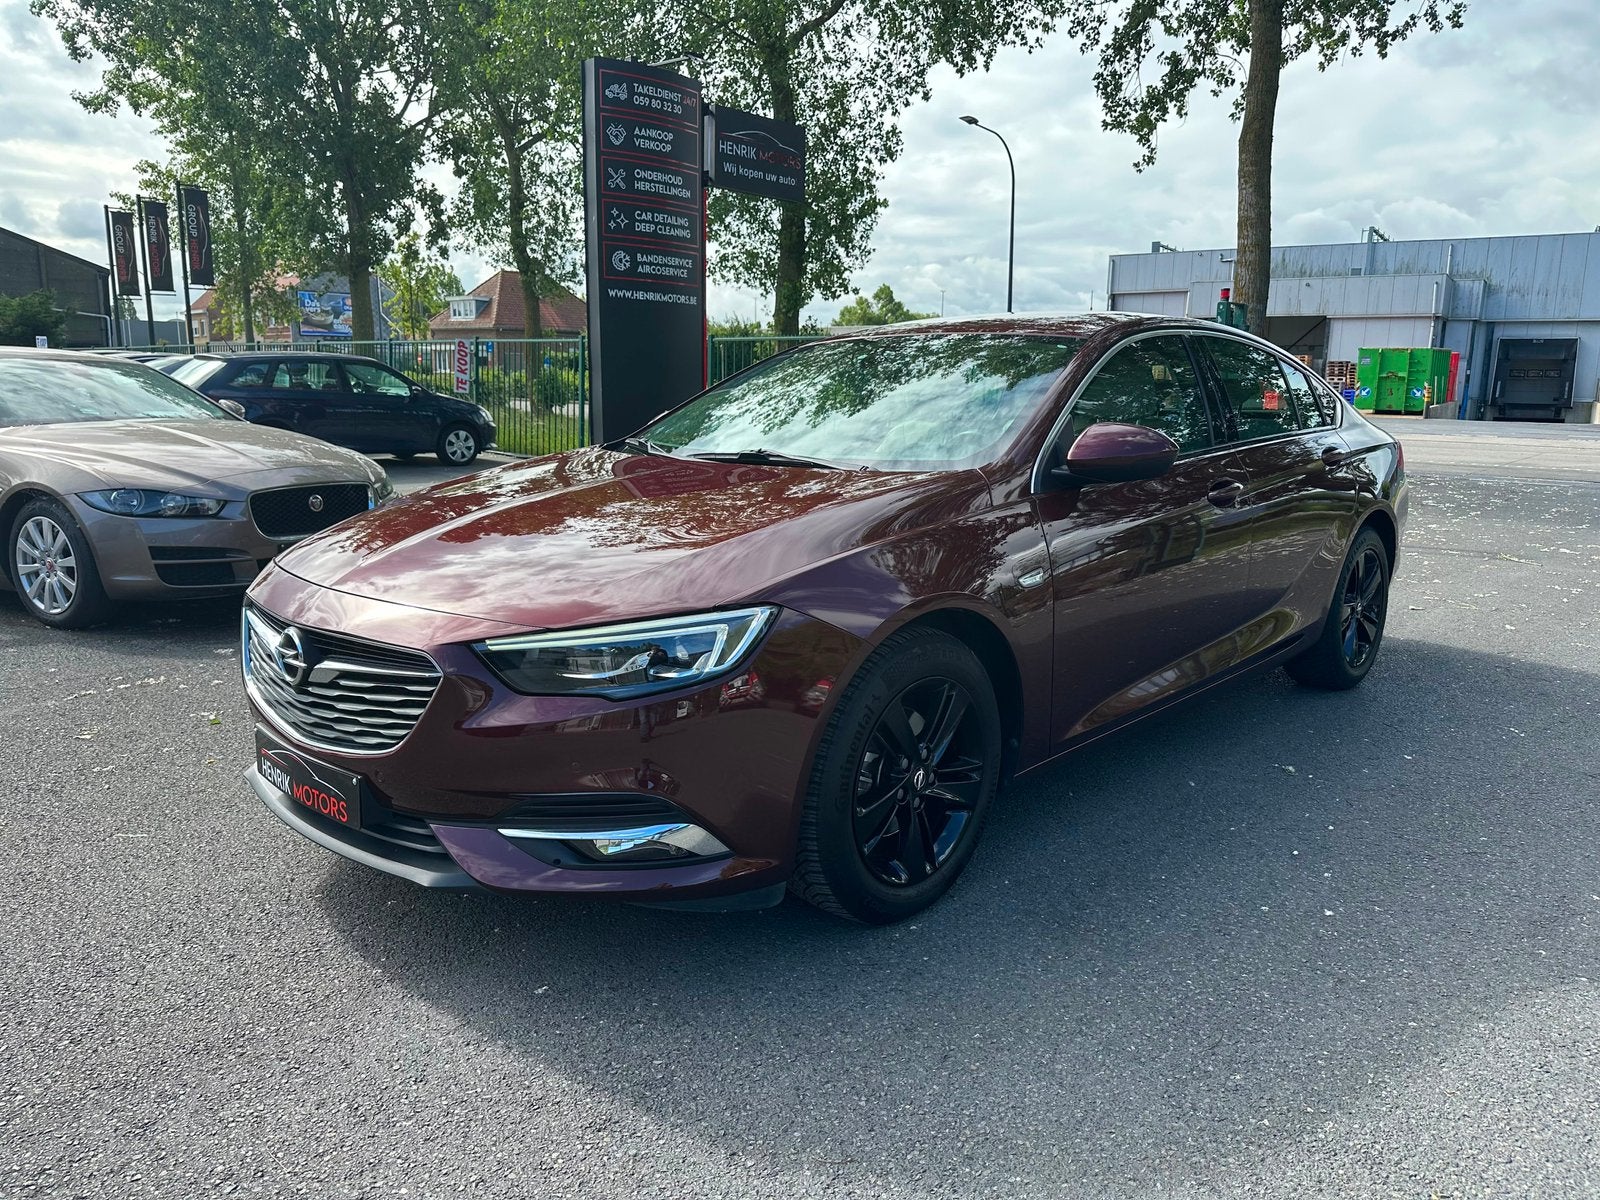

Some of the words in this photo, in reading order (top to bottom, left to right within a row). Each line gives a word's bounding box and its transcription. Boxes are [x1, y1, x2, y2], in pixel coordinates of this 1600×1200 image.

[633, 83, 682, 102] TAKELDIENST
[633, 95, 650, 107] 059
[651, 99, 662, 109] 80
[663, 101, 672, 112] 32
[673, 104, 682, 114] 30
[633, 126, 674, 141] AANKOOP
[633, 137, 672, 152] VERKOOP
[719, 139, 757, 160] HENRIK
[634, 168, 683, 185] ONDERHOUD
[723, 161, 737, 176] Wij
[739, 165, 764, 179] kopen
[765, 172, 778, 182] uw
[778, 175, 796, 186] auto
[634, 180, 691, 198] HERSTELLINGEN
[186, 204, 198, 238] GROUP
[634, 210, 653, 221] CAR
[653, 213, 689, 227] DETAILING
[148, 215, 158, 243] HENRIK
[635, 222, 656, 233] DEEP
[656, 225, 691, 239] CLEANING
[115, 224, 125, 254] GROUP
[636, 253, 693, 268] BANDENSERVICE
[637, 265, 688, 278] AIRCOSERVICE
[607, 288, 698, 305] WWW.HENRIKMOTORS.BE
[457, 340, 469, 375] KOOP
[456, 377, 468, 391] TE
[261, 757, 292, 796] HENRIK
[292, 781, 349, 823] MOTORS
